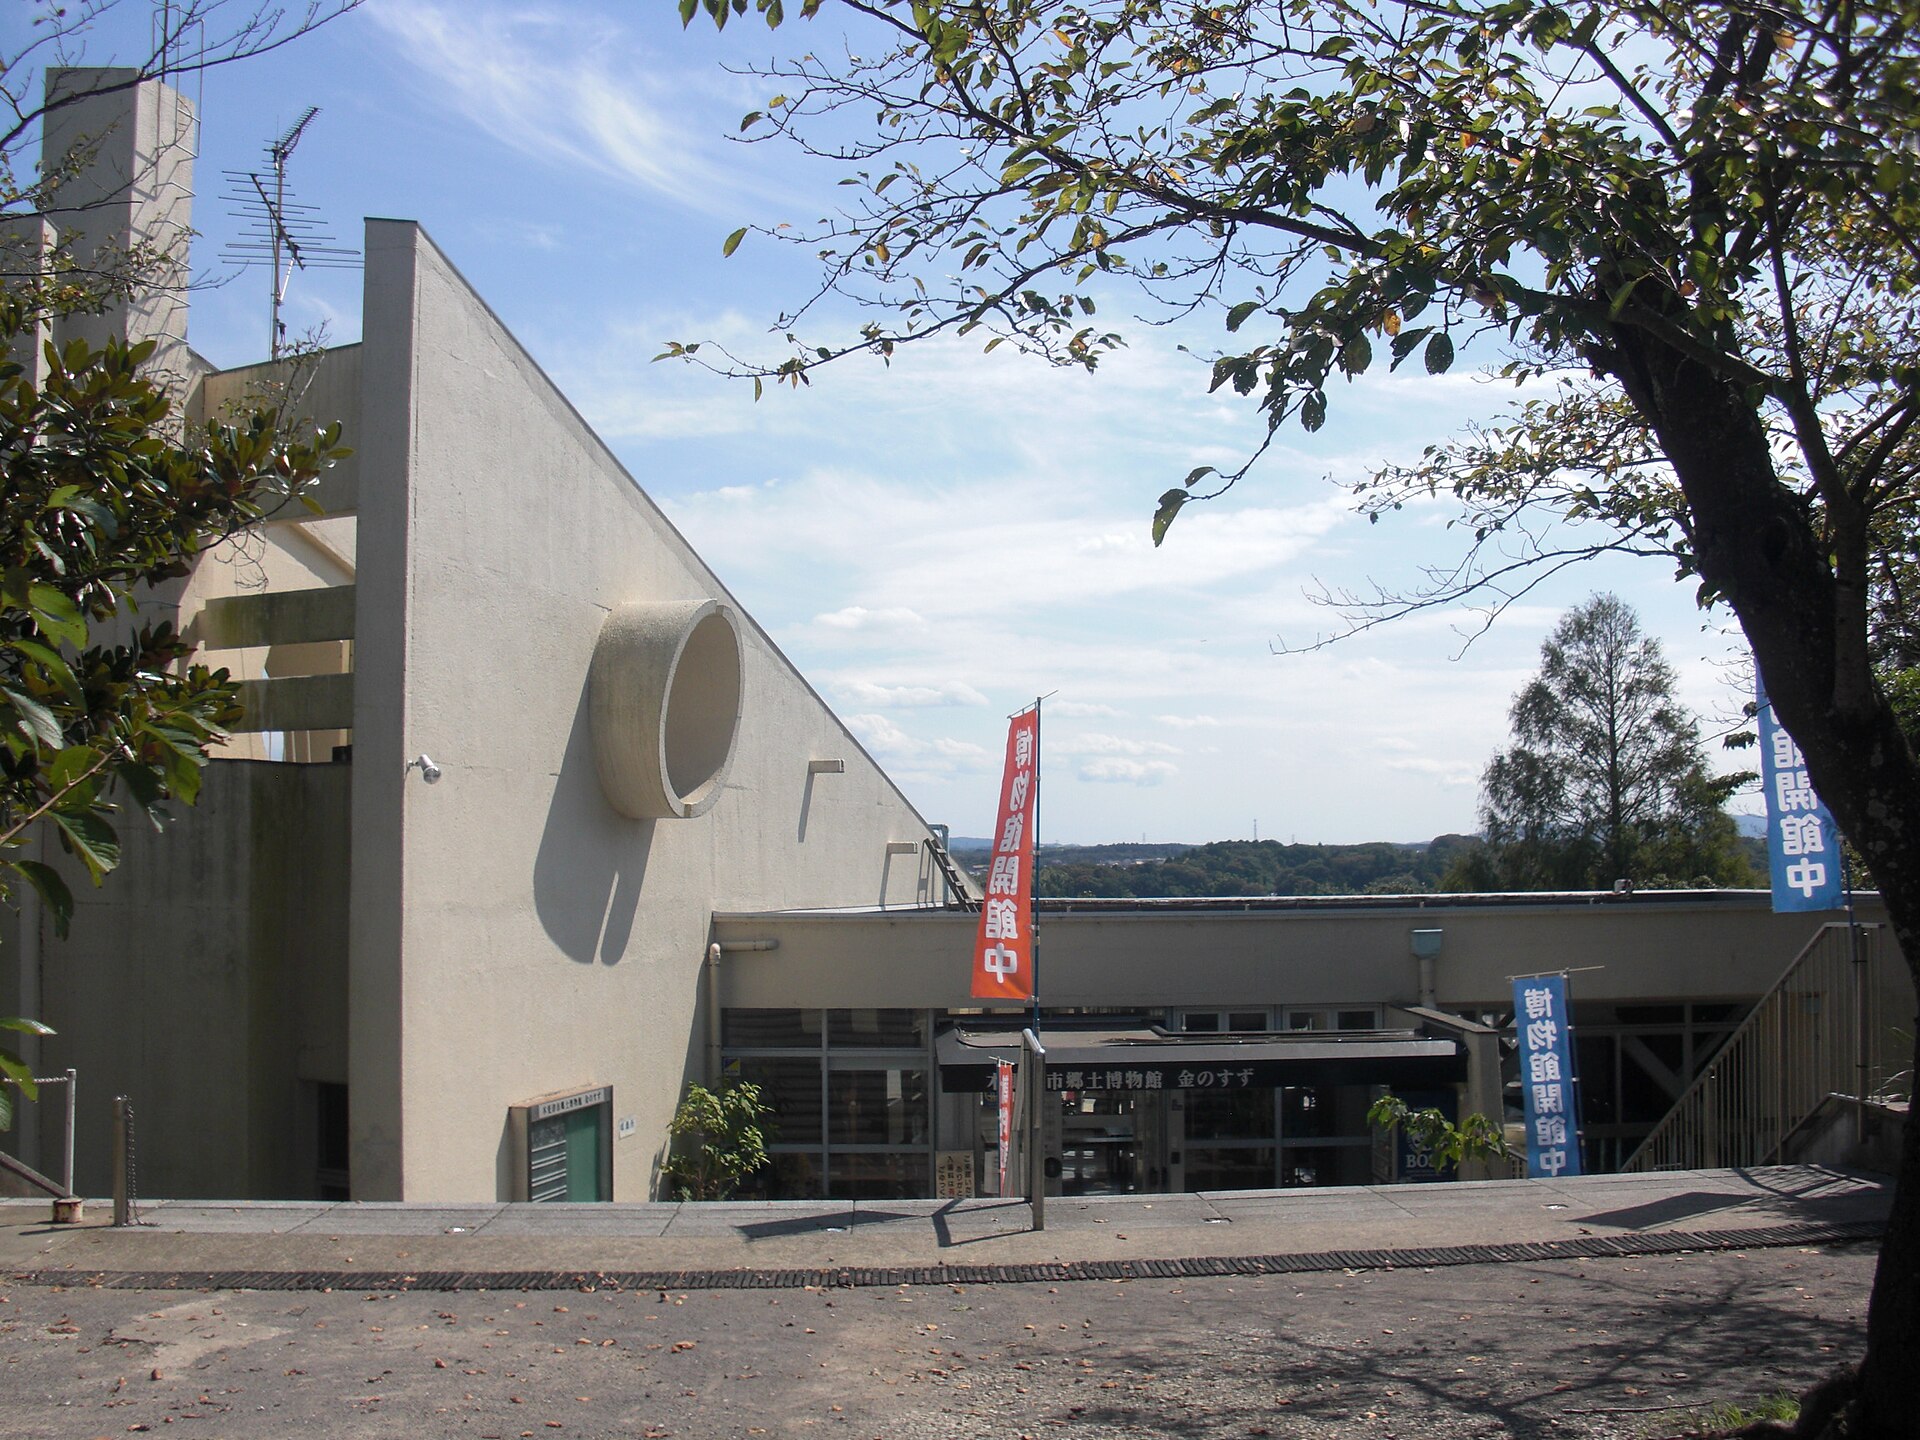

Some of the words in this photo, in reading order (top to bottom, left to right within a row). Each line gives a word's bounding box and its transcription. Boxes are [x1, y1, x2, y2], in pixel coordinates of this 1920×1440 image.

[985, 1070, 1163, 1091] 木市郷土博物館
[1177, 1068, 1255, 1088] 金のすず
